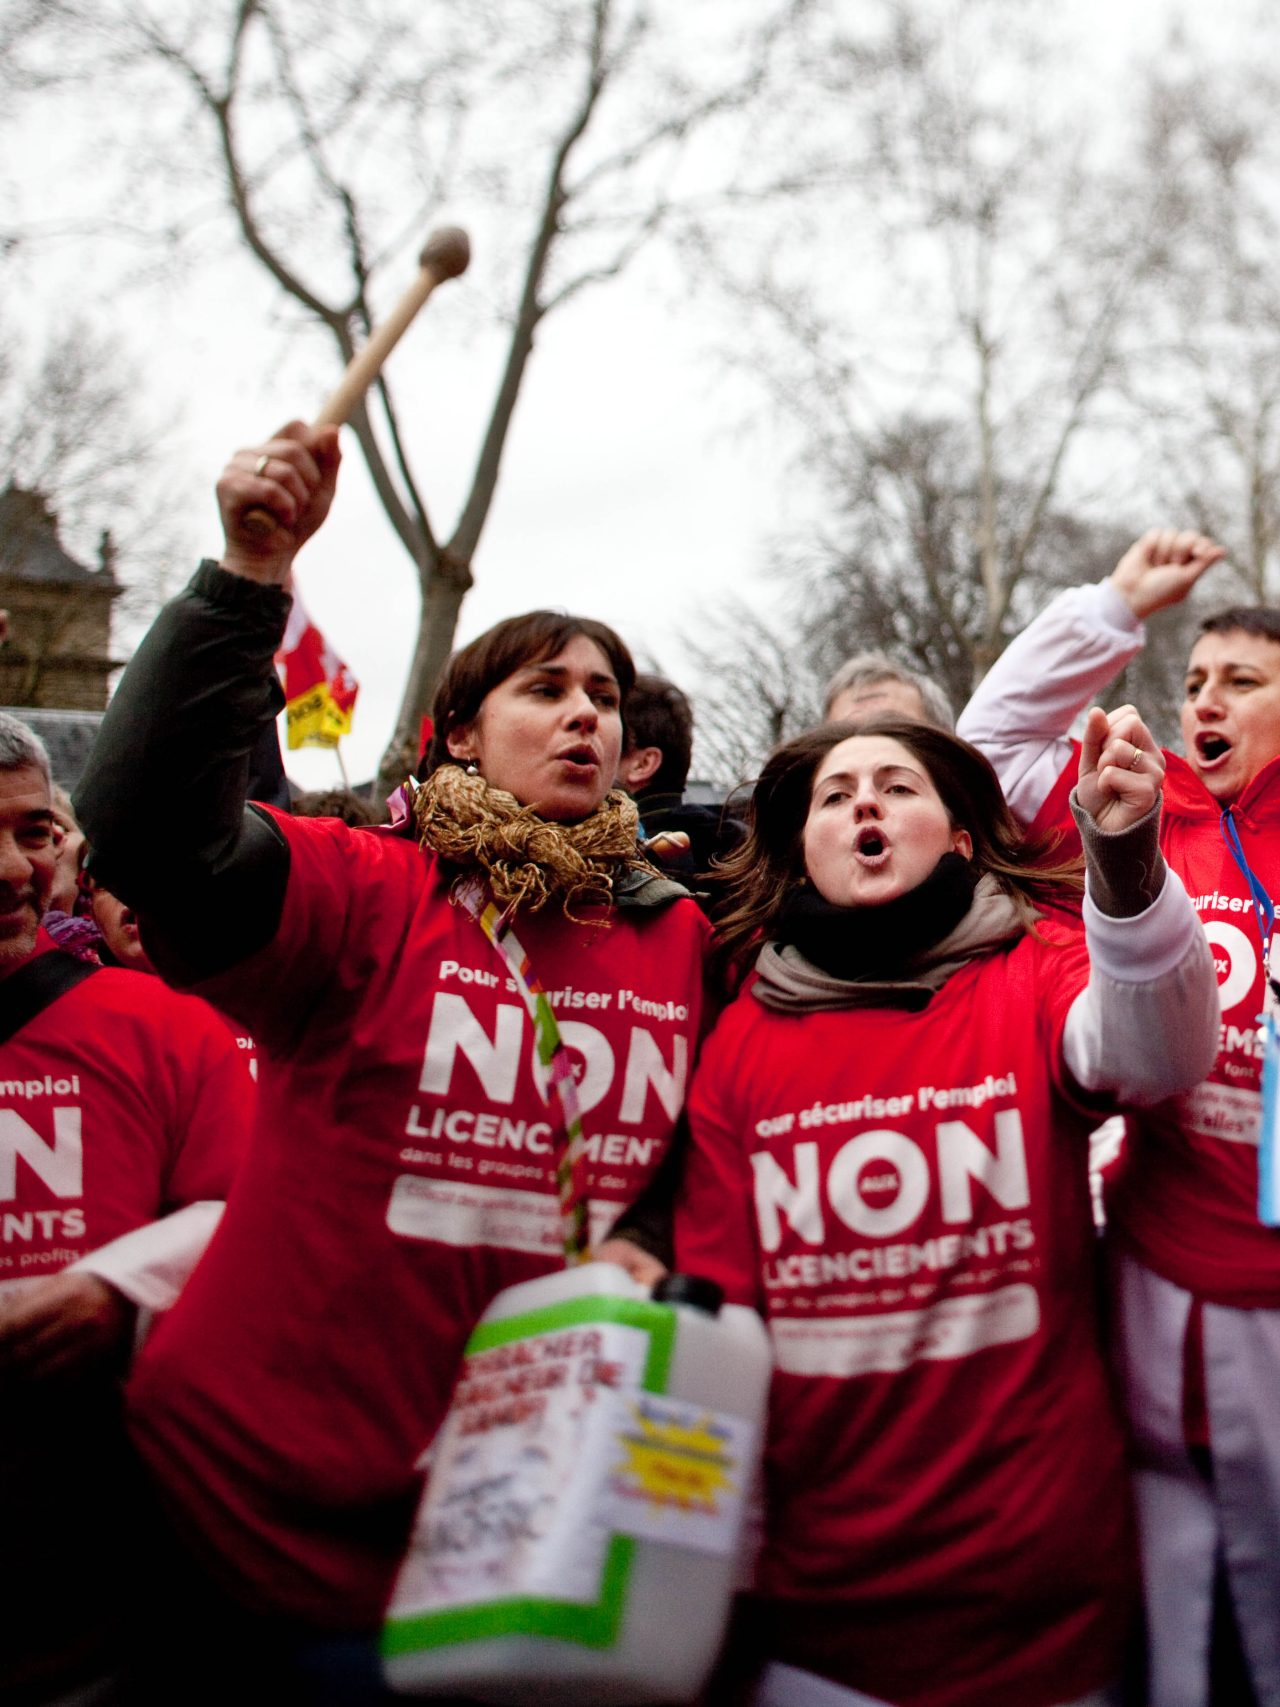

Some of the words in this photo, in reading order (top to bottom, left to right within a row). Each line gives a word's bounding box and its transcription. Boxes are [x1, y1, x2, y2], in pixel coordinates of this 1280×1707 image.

[439, 961, 500, 989] Pour
[618, 989, 689, 1022] l'emplo
[419, 992, 689, 1124] NON
[799, 1094, 914, 1128] sécuriser
[917, 1072, 1017, 1112] l'emploi
[400, 1147, 443, 1167] dans
[447, 1152, 474, 1170] les
[478, 1159, 544, 1182] groupes
[750, 1108, 1030, 1254] NON
[860, 1174, 900, 1194] AUX
